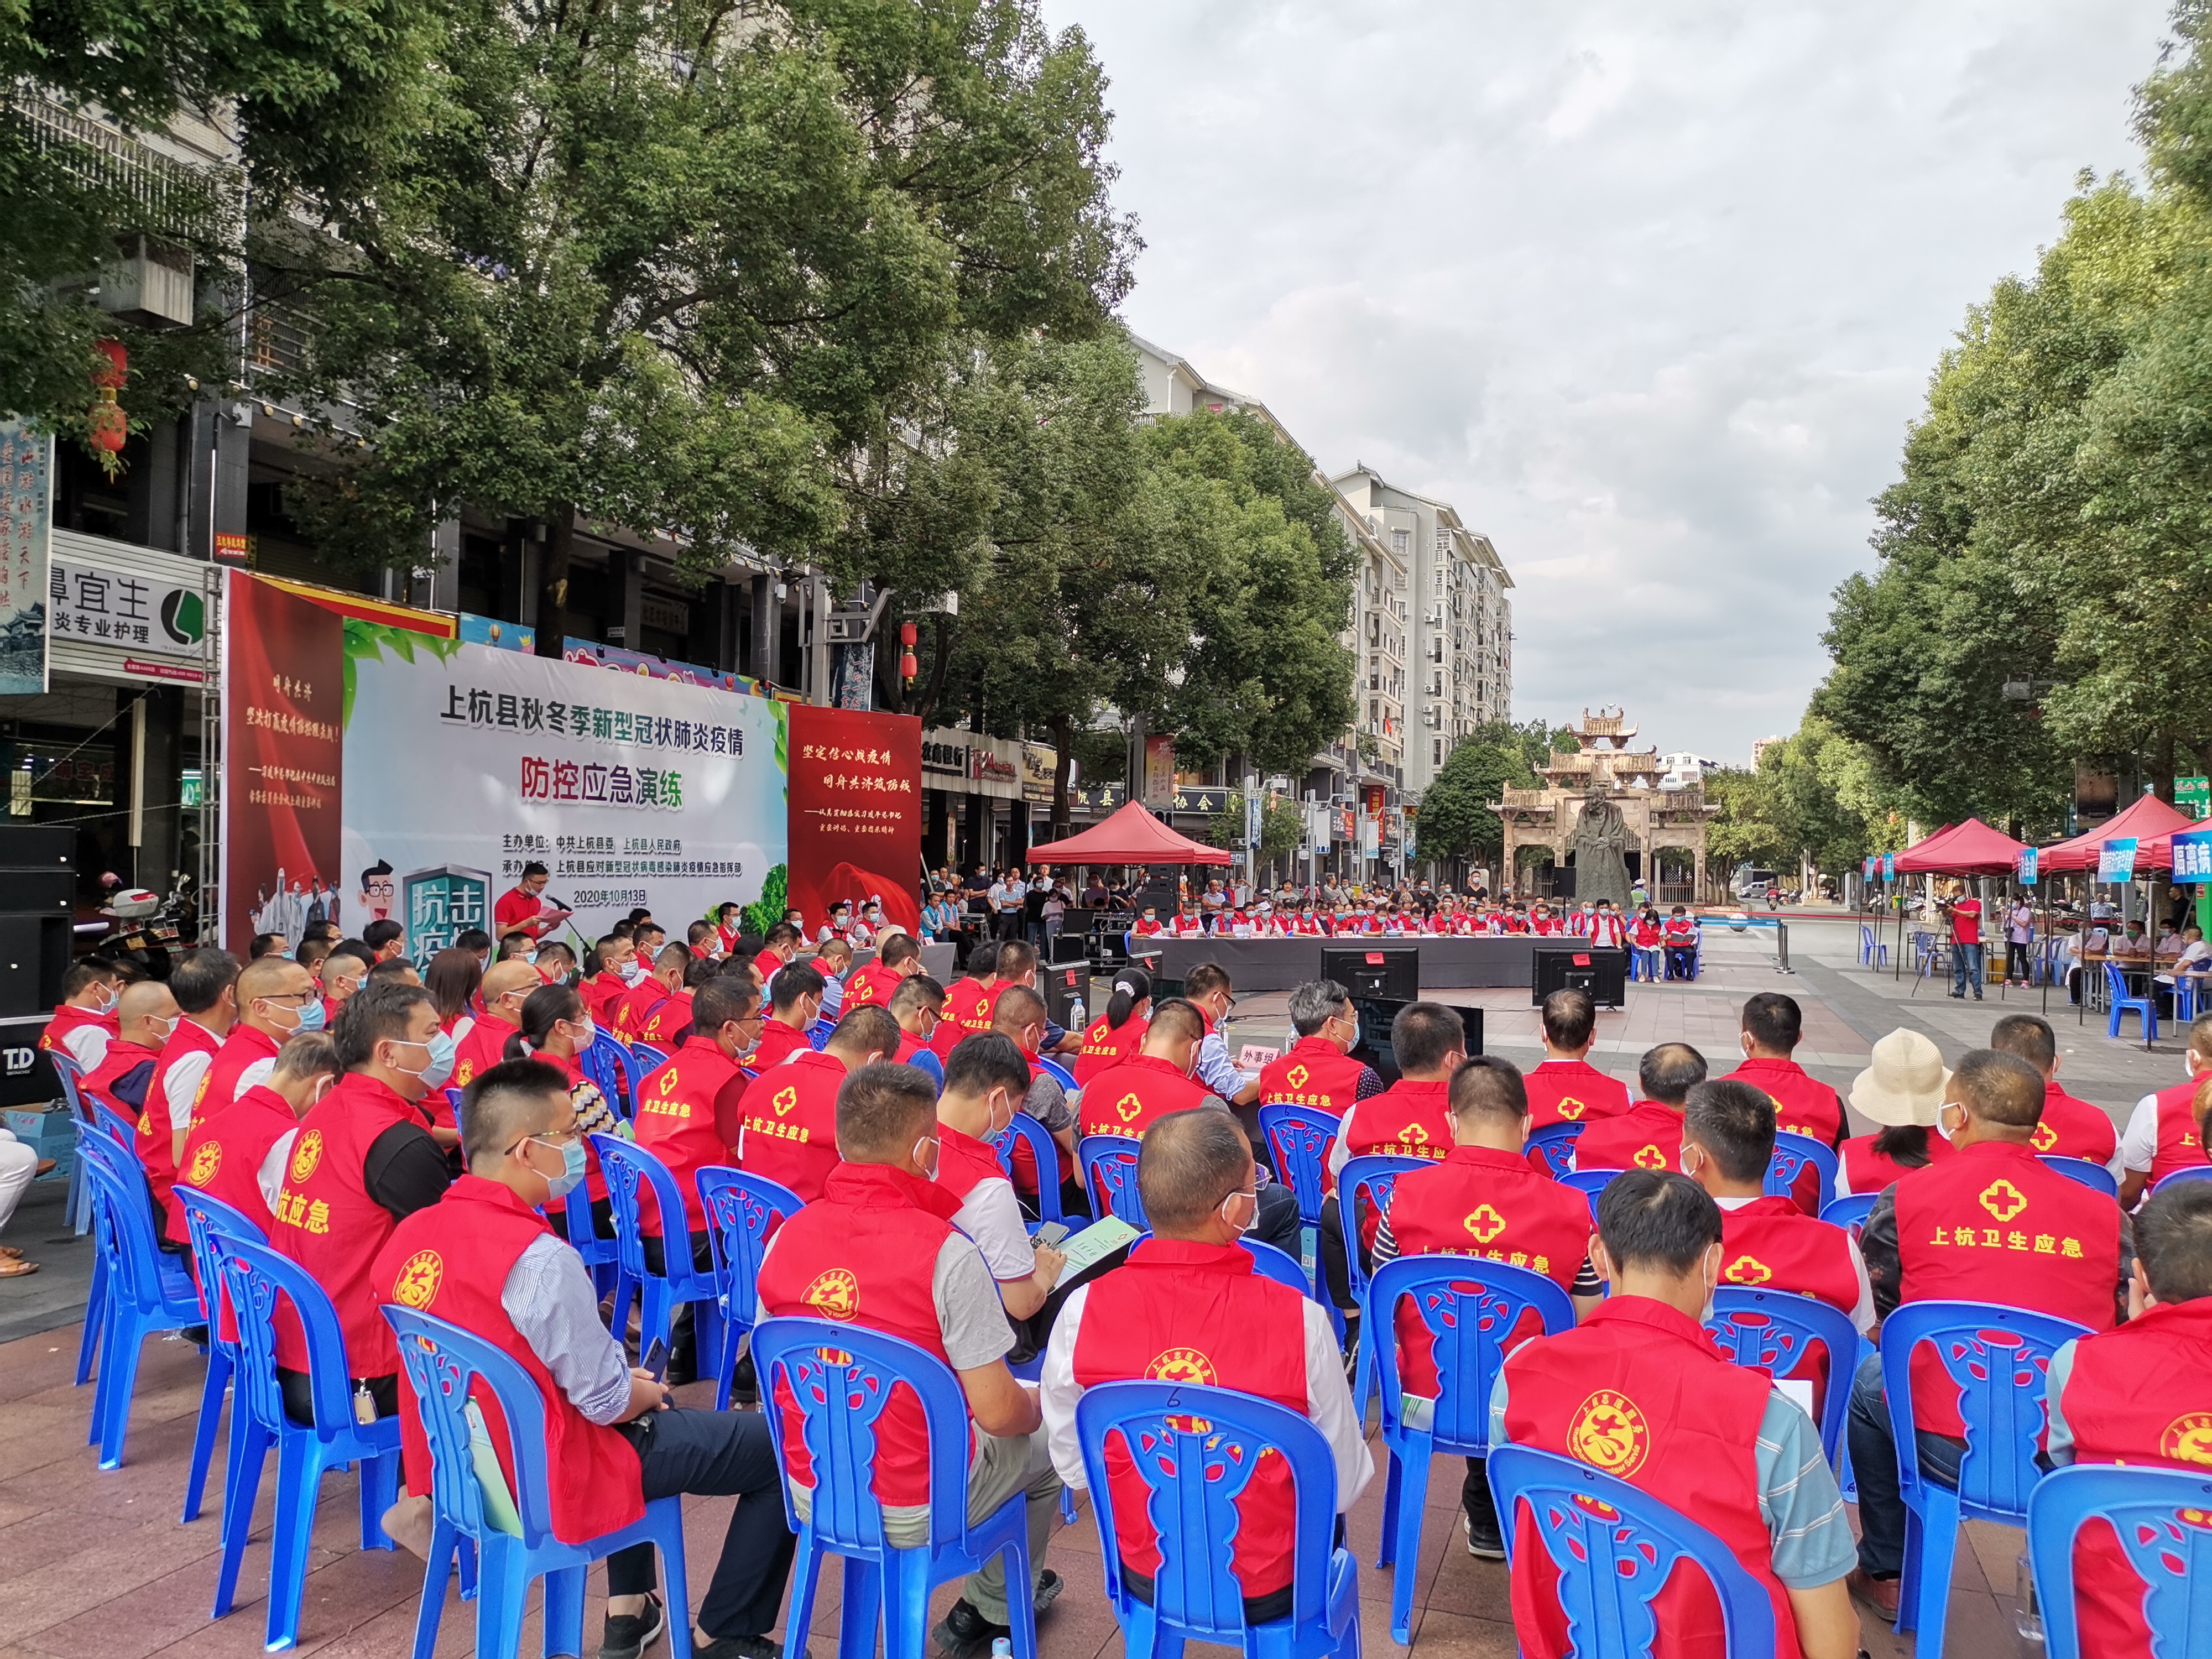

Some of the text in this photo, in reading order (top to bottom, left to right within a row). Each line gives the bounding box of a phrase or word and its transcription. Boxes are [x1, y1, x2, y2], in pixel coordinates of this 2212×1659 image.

[54, 612, 150, 644] 炎专业护理
[440, 684, 743, 756] 上杭县秋冬季新型冠状肺炎疫情
[802, 744, 891, 766] 坚定信心战疫情
[521, 755, 683, 808] 防控应急演练
[823, 773, 911, 793] 同舟共济筑防线
[502, 833, 681, 852] 主办单位： 中共上杭县委 上杭县人民政府
[414, 884, 483, 926] 抗击
[573, 889, 646, 904] 2020年10月13日
[1243, 1049, 1275, 1065] 外事组
[1267, 1092, 1331, 1107] 上杭卫生应急
[744, 1114, 810, 1143] 上杭卫生应急
[1930, 1225, 2084, 1259] 上杭卫生应急
[1167, 1386, 1181, 1407] 6
